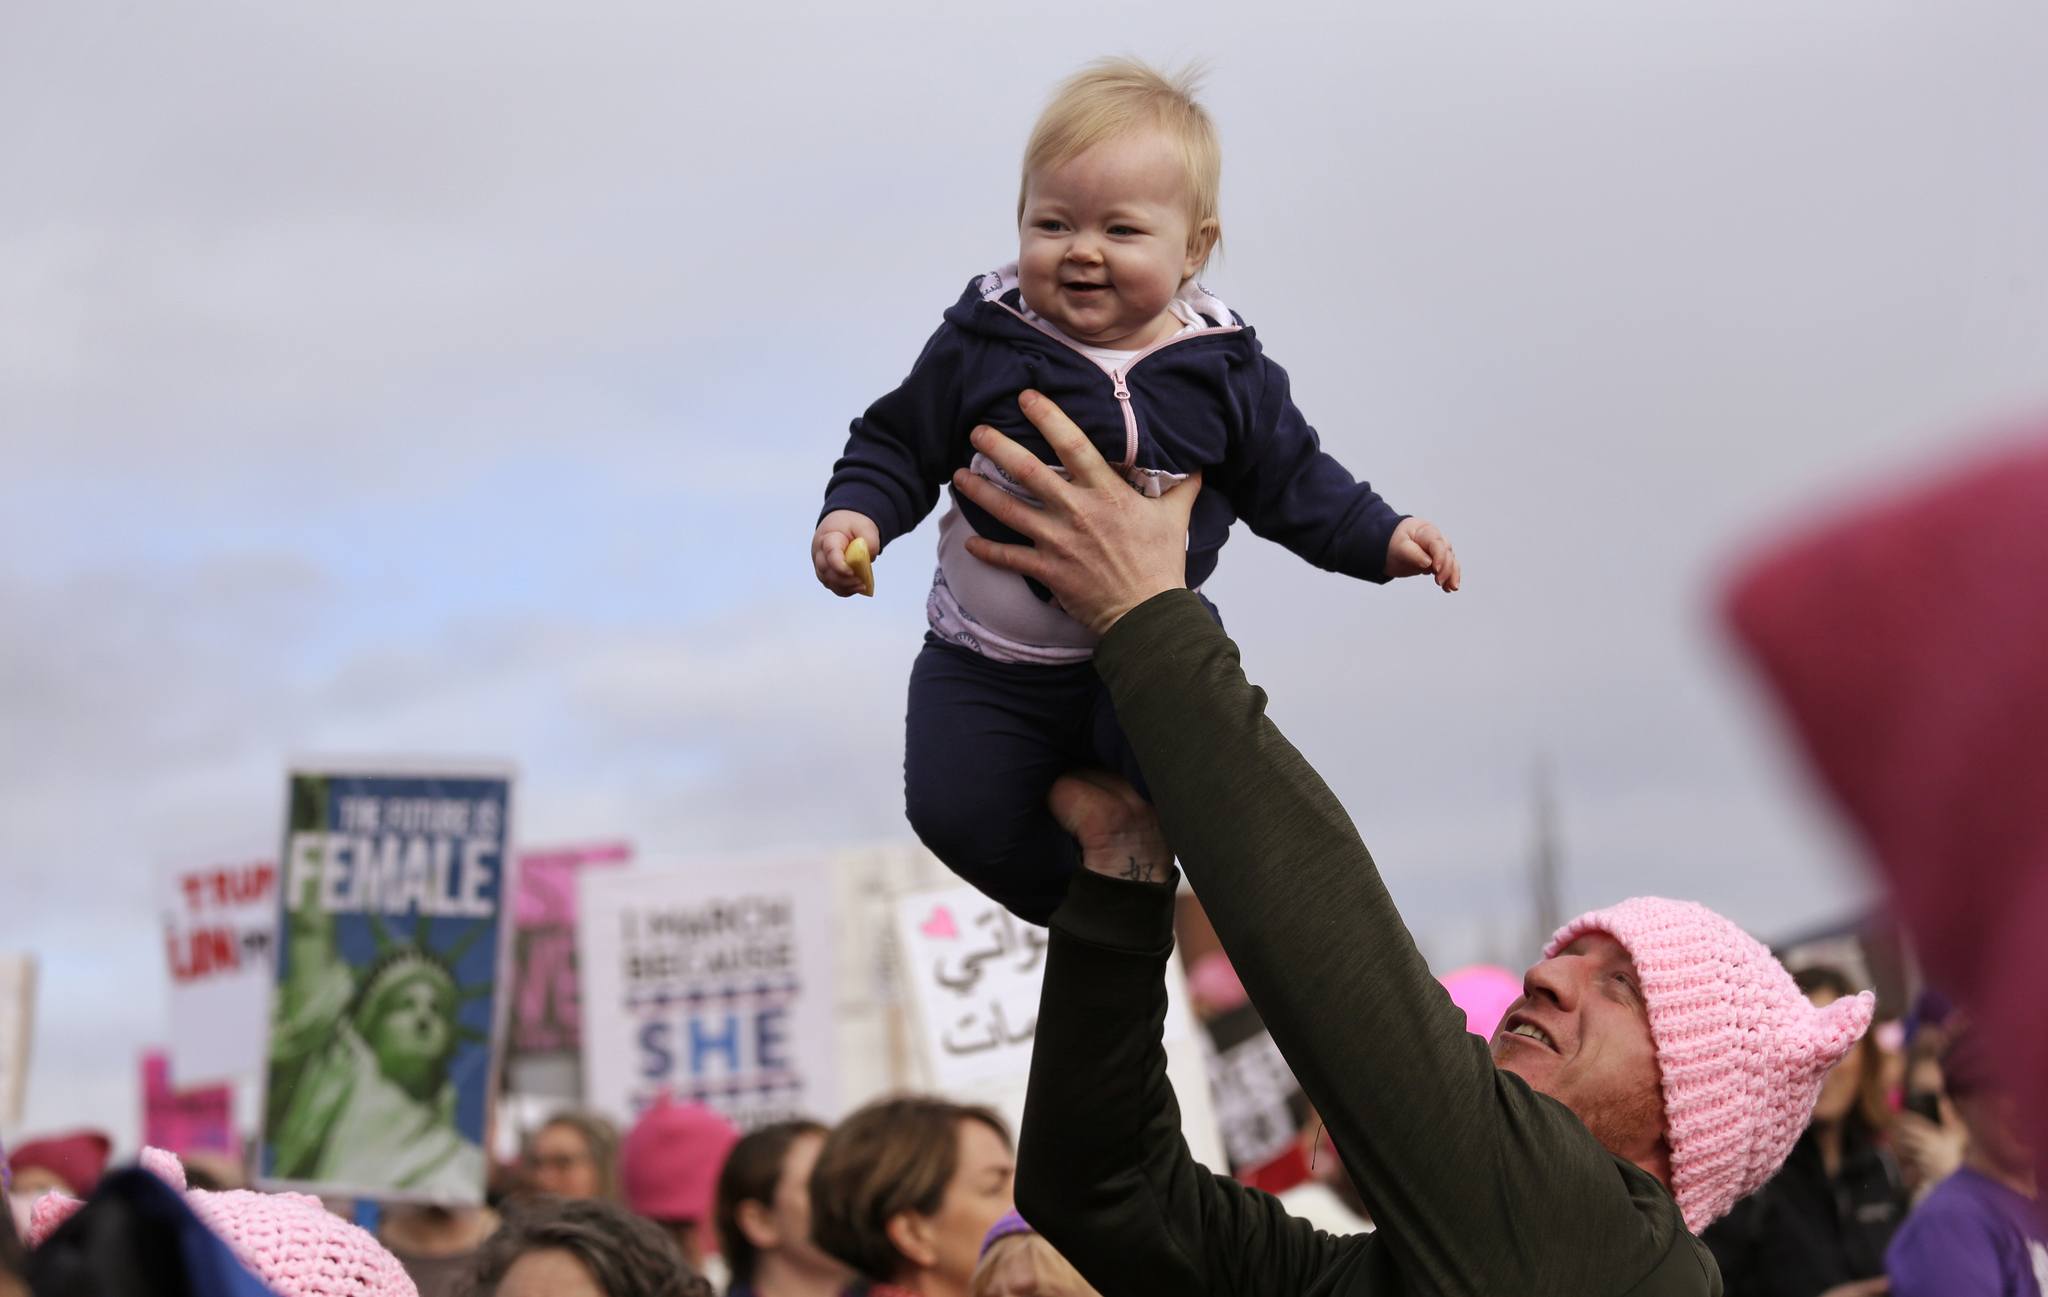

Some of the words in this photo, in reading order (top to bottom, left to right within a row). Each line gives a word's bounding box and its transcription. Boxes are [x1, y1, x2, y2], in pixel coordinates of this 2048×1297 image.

[339, 796, 380, 830] THE
[384, 797, 470, 832] FUTURE
[288, 832, 499, 917] FEMALE
[648, 895, 793, 938] MARCH
[627, 943, 792, 980] BECAUSE
[637, 1007, 791, 1080] SHE
